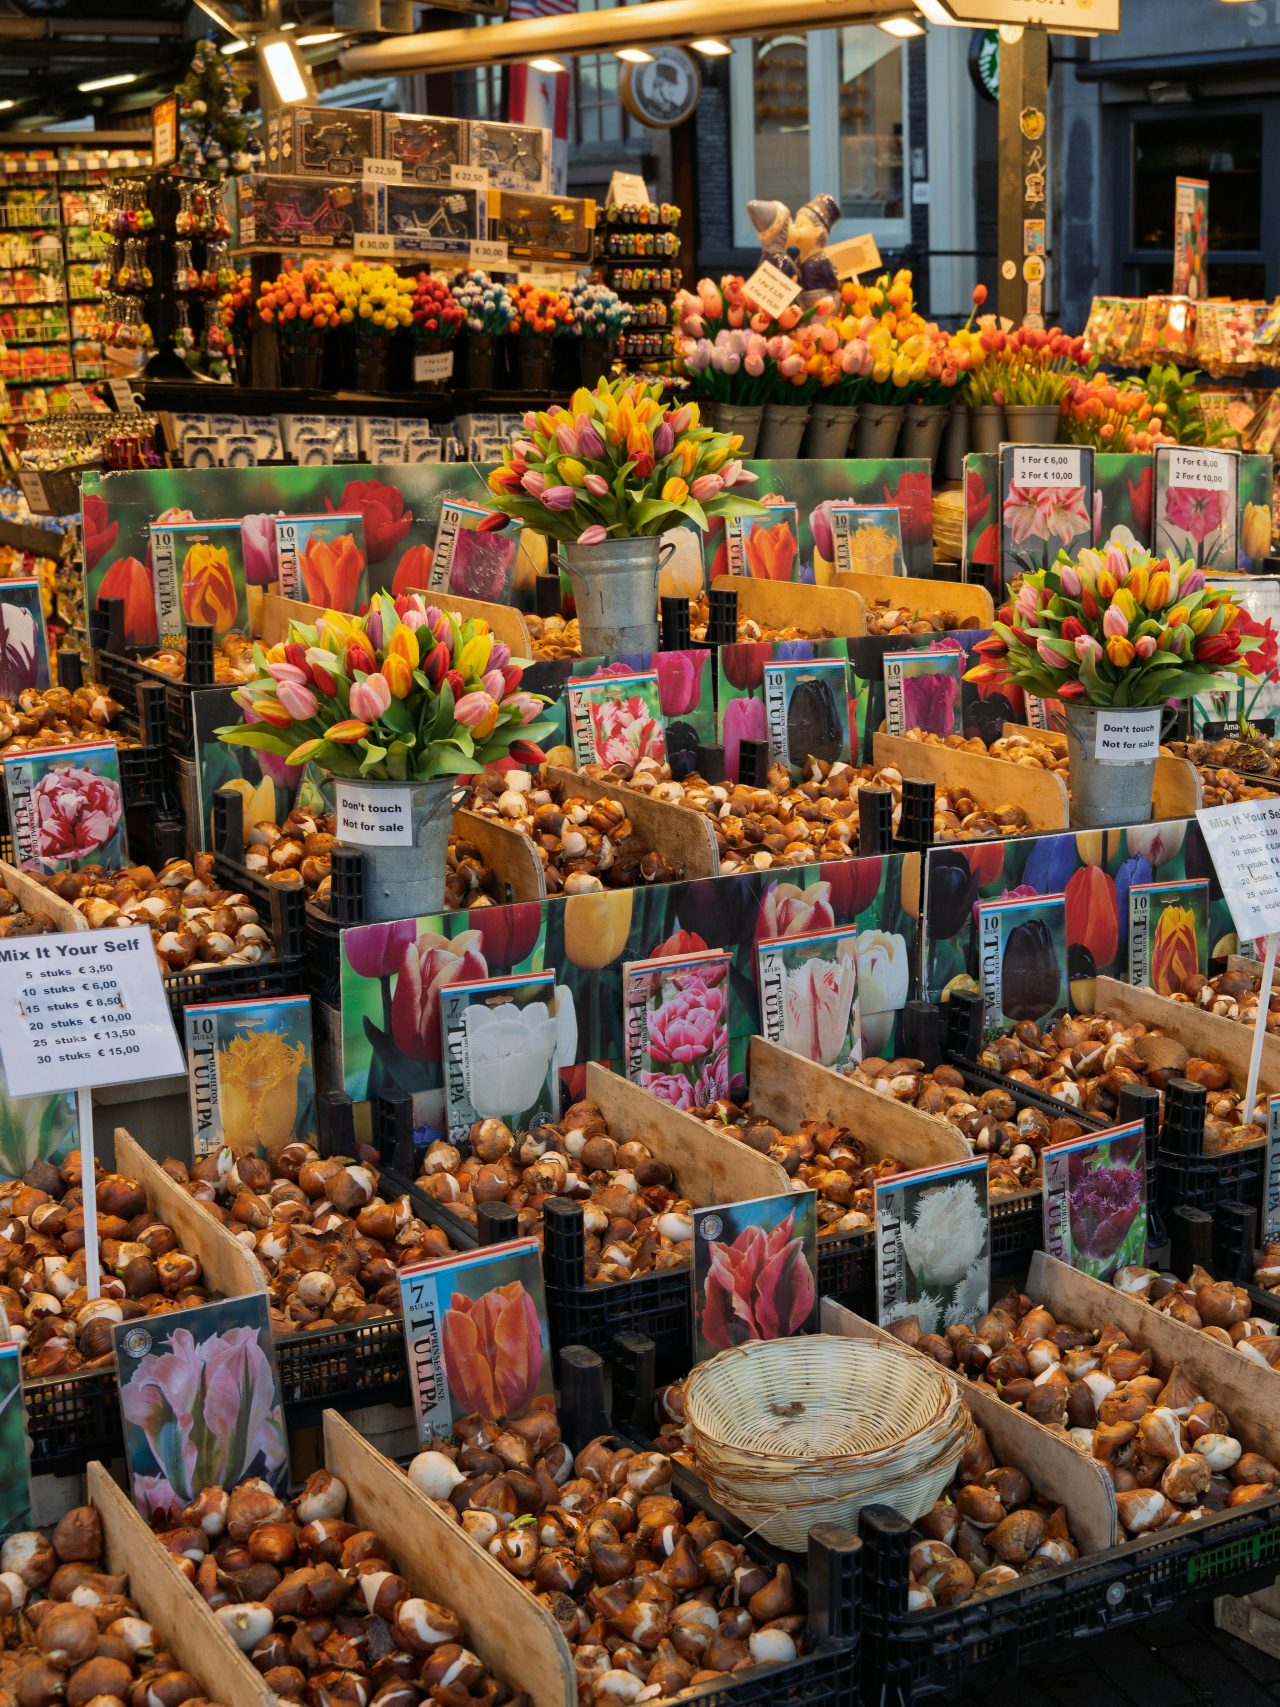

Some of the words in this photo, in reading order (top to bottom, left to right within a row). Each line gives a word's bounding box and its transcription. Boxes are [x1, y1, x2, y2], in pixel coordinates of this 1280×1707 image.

[375, 166, 396, 176] 22,50
[462, 173, 483, 182] 22,50
[367, 242, 389, 250] 30,00
[482, 249, 503, 257] 30,00
[1028, 456, 1041, 464] For
[1051, 457, 1068, 465] 6,00
[1051, 472, 1073, 481] 10,00
[445, 510, 459, 523] 10
[155, 534, 171, 545] 10
[432, 528, 455, 586] TULIPA
[156, 551, 172, 617] TULIPA
[887, 665, 900, 675] 10
[768, 674, 782, 686] 10
[769, 692, 784, 757] TULIPA
[1103, 724, 1130, 734] Don't
[1132, 724, 1155, 733] touch
[1224, 722, 1256, 731] Amalis
[1102, 740, 1121, 749] Not
[1123, 740, 1137, 749] for
[1138, 740, 1154, 748] sale
[13, 767, 23, 779] 7
[342, 799, 365, 812] Don't
[368, 804, 402, 813] touch
[13, 787, 33, 863] TULIPA
[27, 802, 35, 838] CARNAVAL
[343, 818, 358, 829] Not
[361, 822, 375, 831] for
[379, 824, 404, 832] sale
[1208, 818, 1231, 829] Mix
[1232, 816, 1242, 826] It
[1243, 812, 1266, 823] Your
[1238, 832, 1257, 841] stuks
[1265, 828, 1278, 836] 3,50
[1244, 846, 1262, 855] stuks
[1248, 860, 1268, 869] stuks
[1254, 874, 1274, 883] stuks
[1260, 888, 1278, 896] stuks
[1134, 897, 1147, 910] 10
[984, 917, 998, 930] 10
[0, 949, 30, 962] Mix
[37, 946, 50, 959] It
[55, 944, 98, 957] Your
[104, 939, 140, 953] Self
[1133, 916, 1147, 986] TULIPA
[767, 954, 775, 967] 7
[40, 969, 72, 978] stuks
[89, 964, 113, 974] 3,50
[984, 936, 999, 1010] TULIPA
[22, 988, 36, 997] 10
[43, 985, 76, 995] stuks
[82, 983, 90, 991] €
[92, 980, 117, 990] 6,00
[26, 1005, 40, 1014] 15
[47, 1001, 79, 1012] stuks
[96, 997, 121, 1007] 8,50
[765, 973, 781, 1042] TULIP
[29, 1022, 43, 1031] 20
[51, 1018, 83, 1029] stuks
[90, 1016, 97, 1024] €
[101, 1013, 132, 1023] 10,00
[192, 1019, 213, 1035] 10
[33, 1039, 48, 1048] 25
[55, 1035, 87, 1045] stuks
[104, 1028, 136, 1039] 13,50
[629, 996, 647, 1075] TULIPA
[37, 1055, 51, 1064] 30
[59, 1051, 91, 1062] stuks
[98, 1049, 105, 1057] €
[108, 1044, 140, 1056] 15,00
[448, 1020, 467, 1105] TULIPA
[193, 1042, 214, 1132] TULIPA
[210, 1060, 218, 1105] HAMILTON
[1052, 1161, 1059, 1175] 7
[1048, 1174, 1065, 1182] BULBS
[1048, 1181, 1066, 1257] TULIP
[882, 1216, 901, 1308] TULIPA
[412, 1284, 424, 1303] 7
[409, 1301, 434, 1312] BULBS
[411, 1311, 438, 1416] TULIPA
[431, 1332, 441, 1371] PRINSES
[436, 1372, 445, 1401] IRENE
